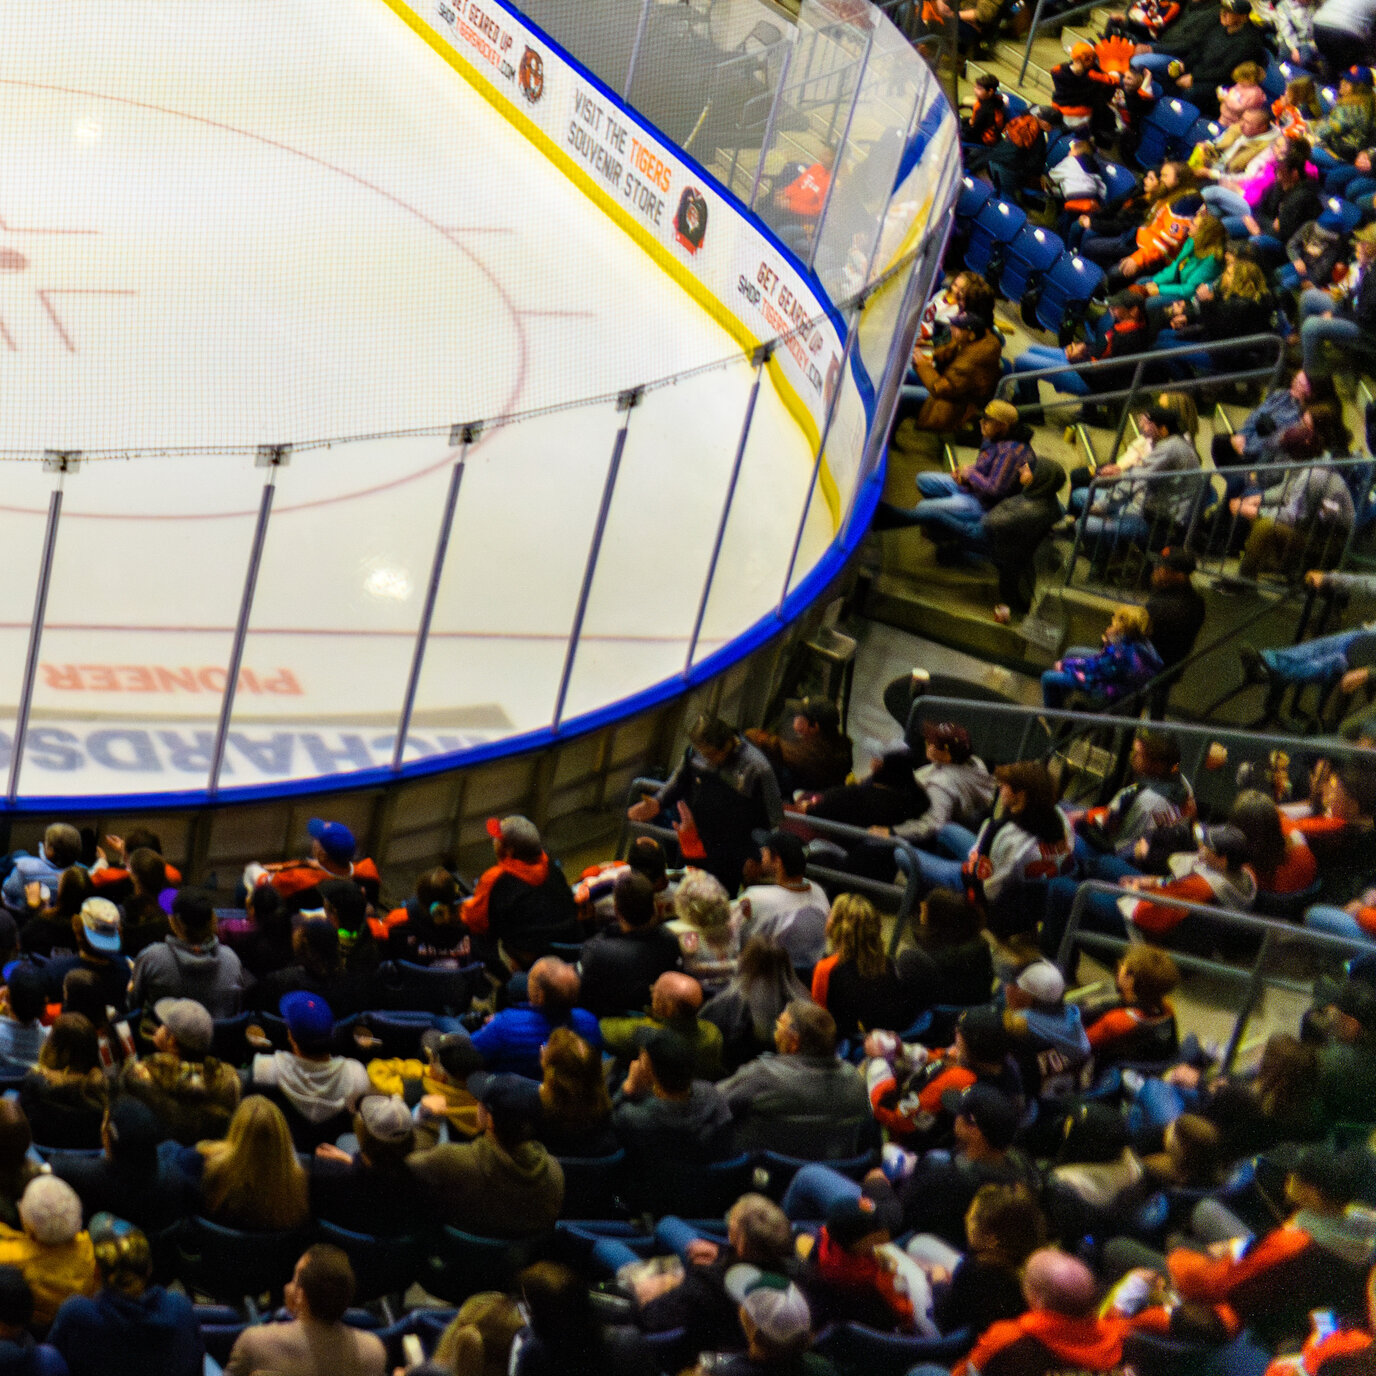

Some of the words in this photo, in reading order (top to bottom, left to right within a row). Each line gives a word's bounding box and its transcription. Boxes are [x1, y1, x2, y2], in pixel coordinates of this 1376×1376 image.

[468, 3, 500, 44] GEARED
[499, 31, 514, 55] UP
[575, 87, 604, 126] VISIT
[605, 112, 628, 155] THE
[630, 137, 672, 193] TIGERS
[567, 120, 624, 188] SOUVENIR
[623, 171, 665, 227] STORE
[756, 260, 780, 297] GET
[42, 661, 306, 700] PIONEER
